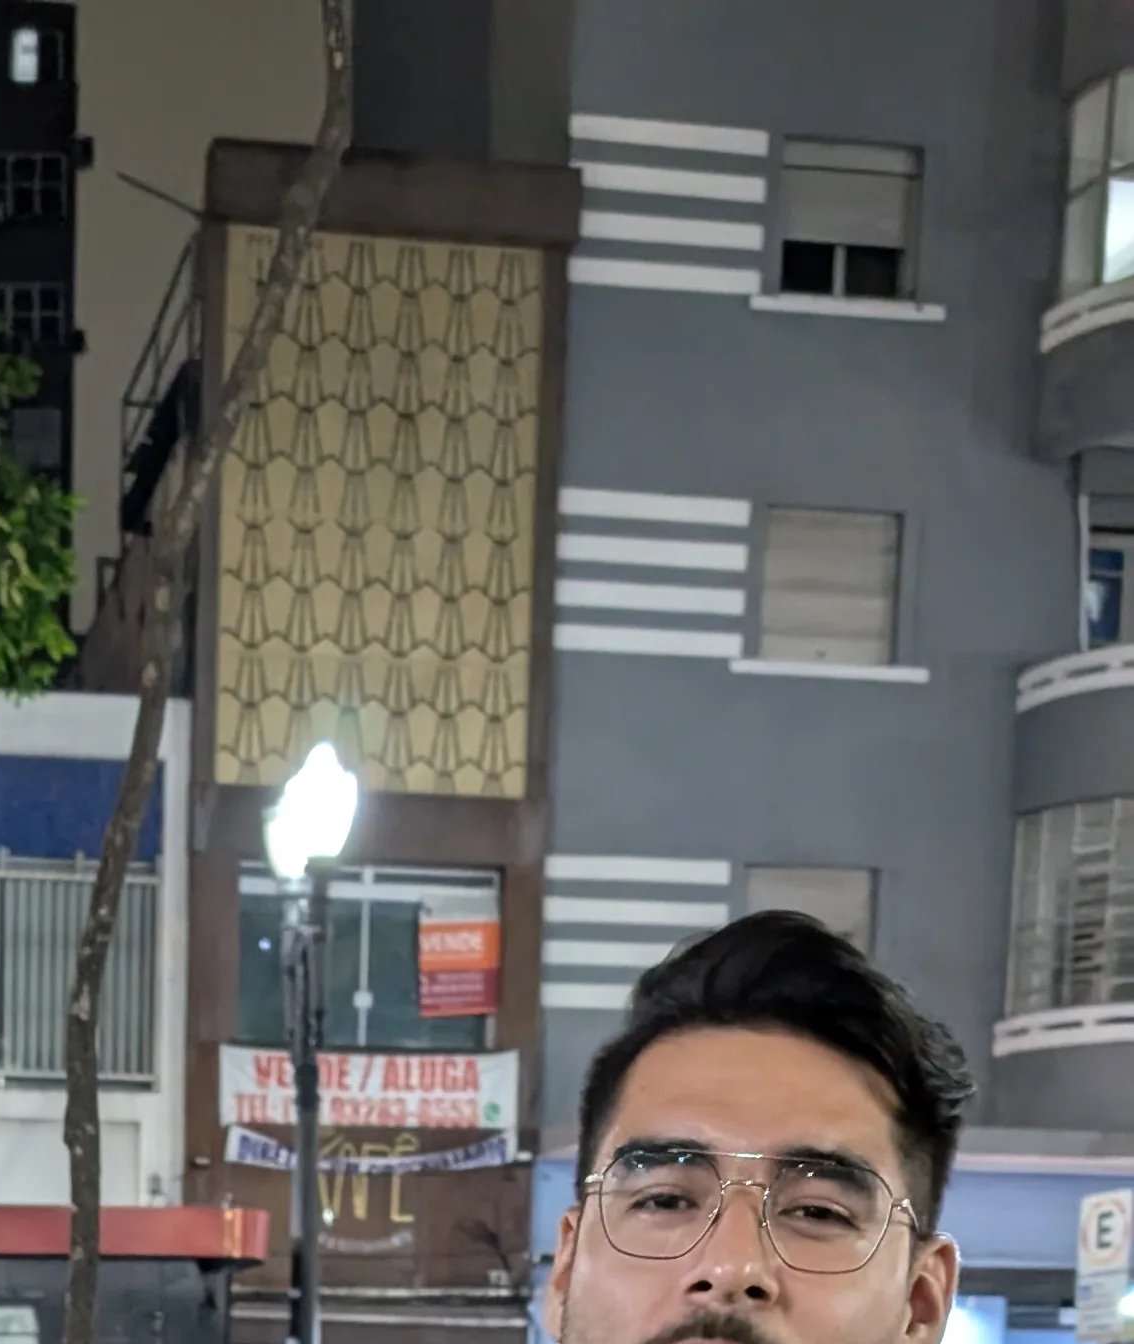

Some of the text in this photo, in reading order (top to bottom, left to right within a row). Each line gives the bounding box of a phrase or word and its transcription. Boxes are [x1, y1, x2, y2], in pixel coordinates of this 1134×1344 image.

[252, 1054, 352, 1089] VEDE
[383, 1055, 480, 1092] ALUGA
[1097, 1210, 1114, 1249] E
